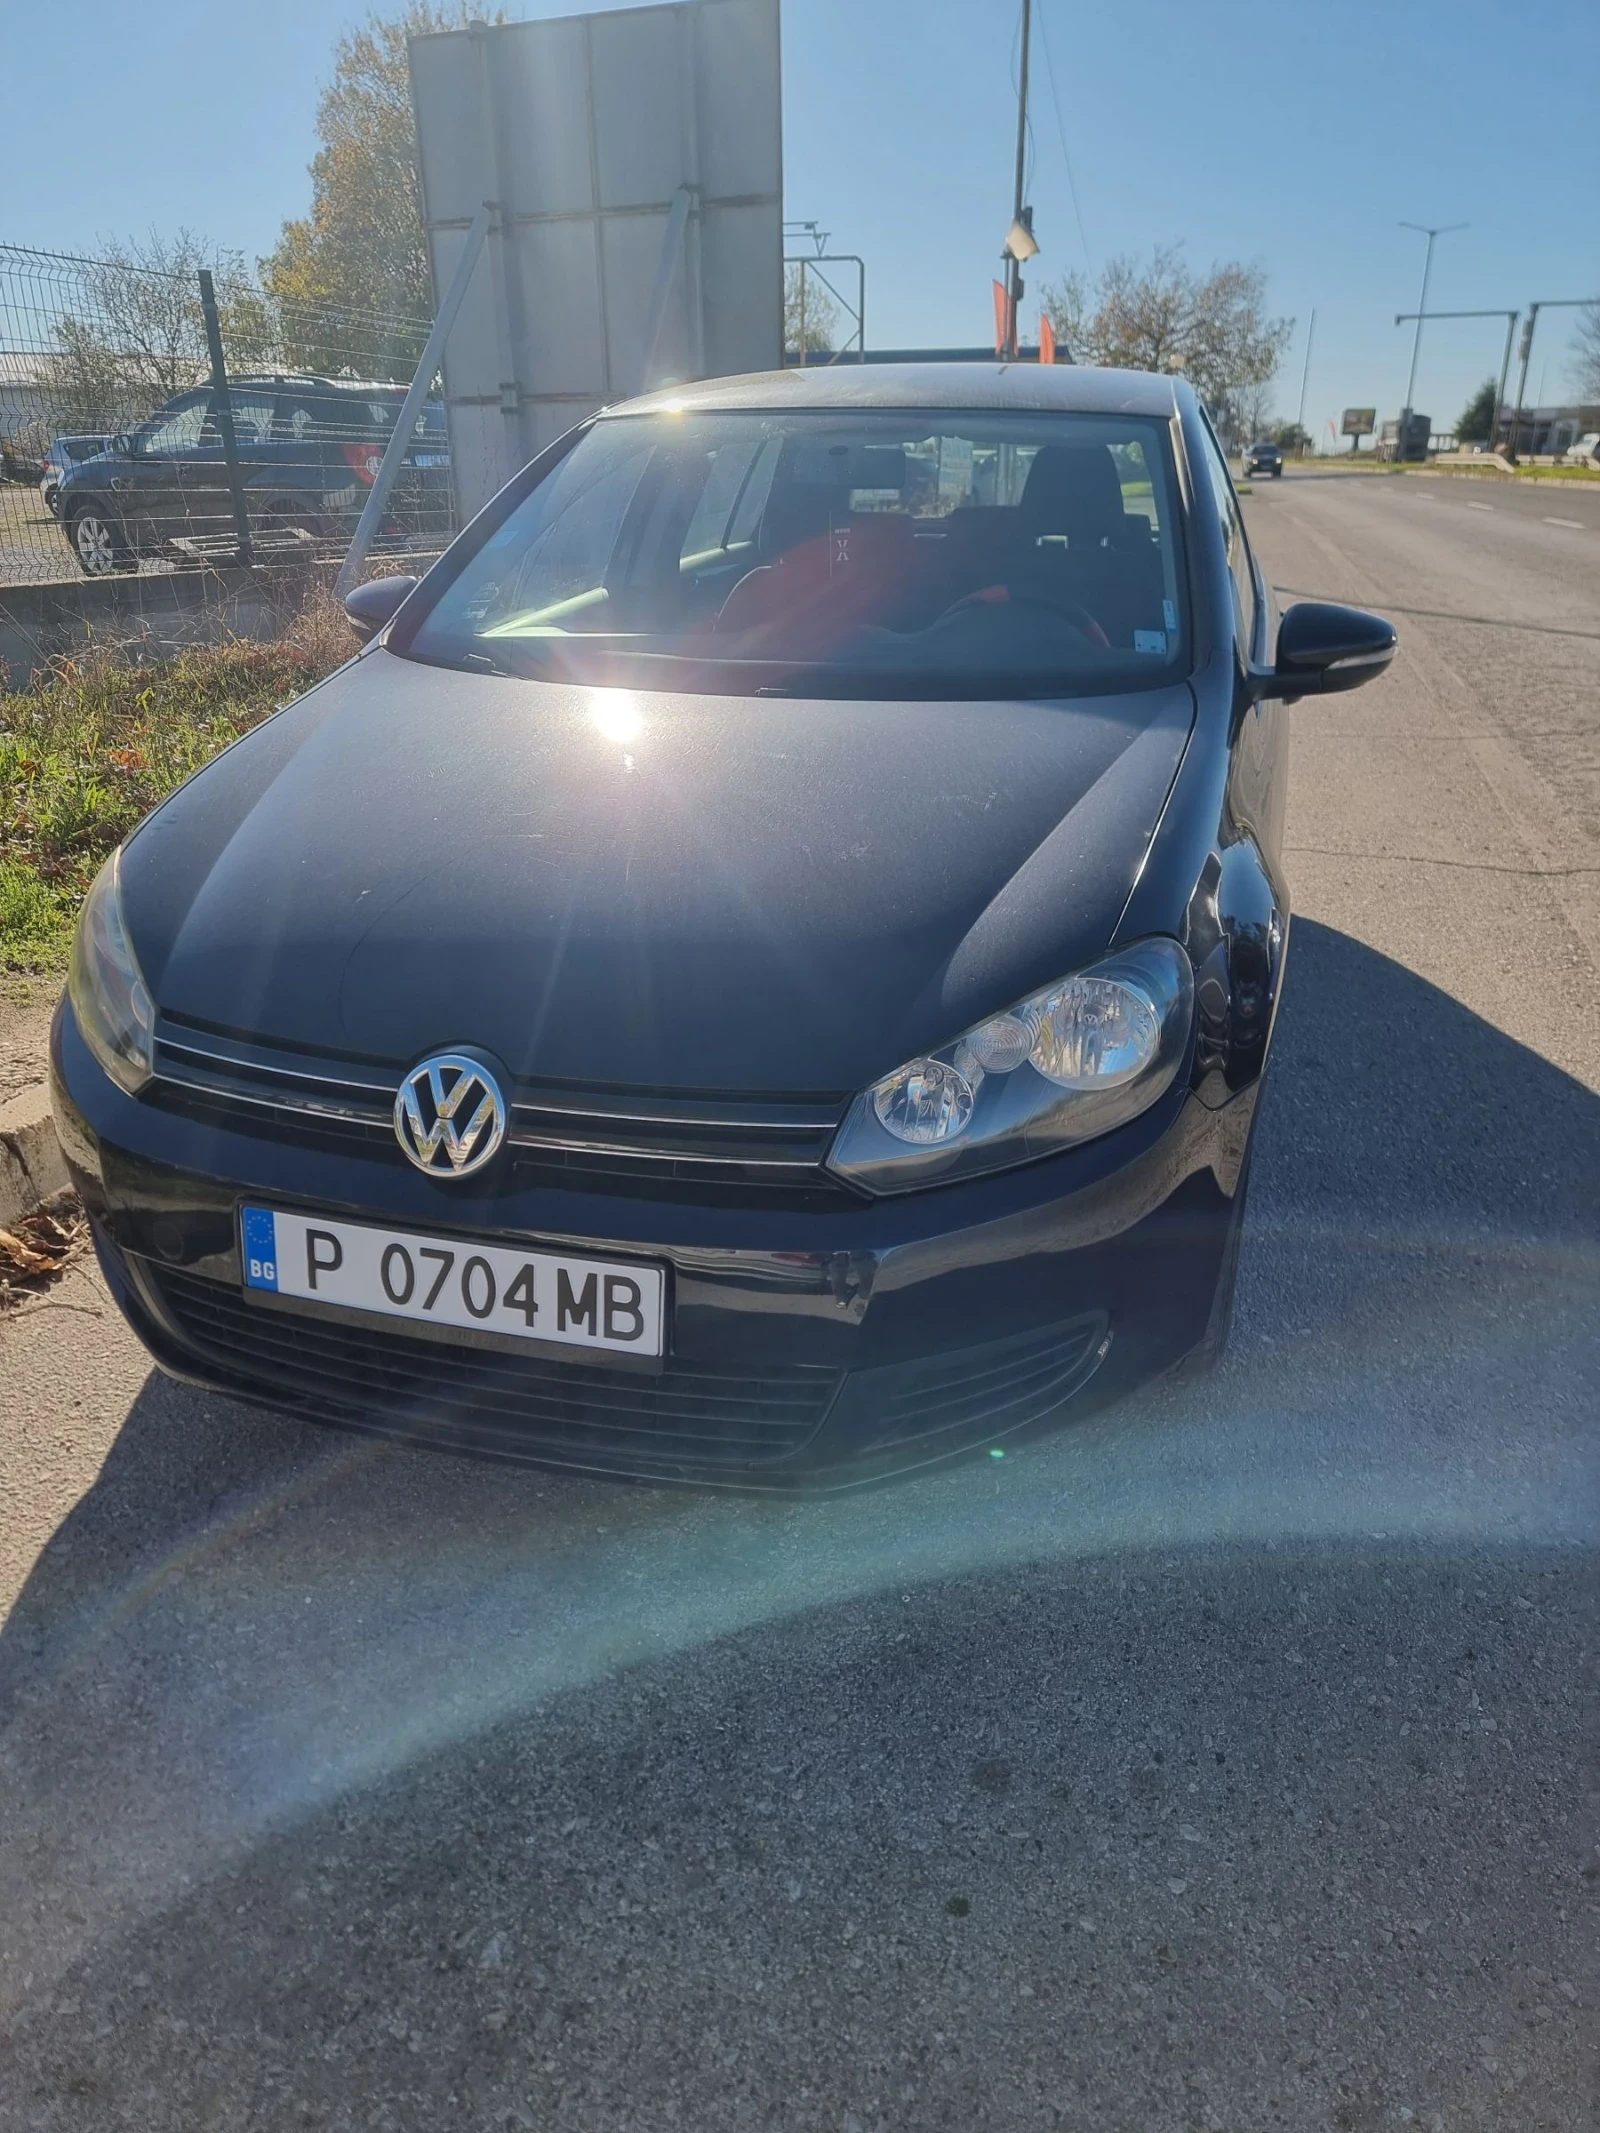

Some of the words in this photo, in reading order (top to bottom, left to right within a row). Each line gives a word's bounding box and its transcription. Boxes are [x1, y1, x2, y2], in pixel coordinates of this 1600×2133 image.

[394, 1055, 505, 1177] VW
[250, 1259, 275, 1280] BG
[306, 1228, 343, 1290] P
